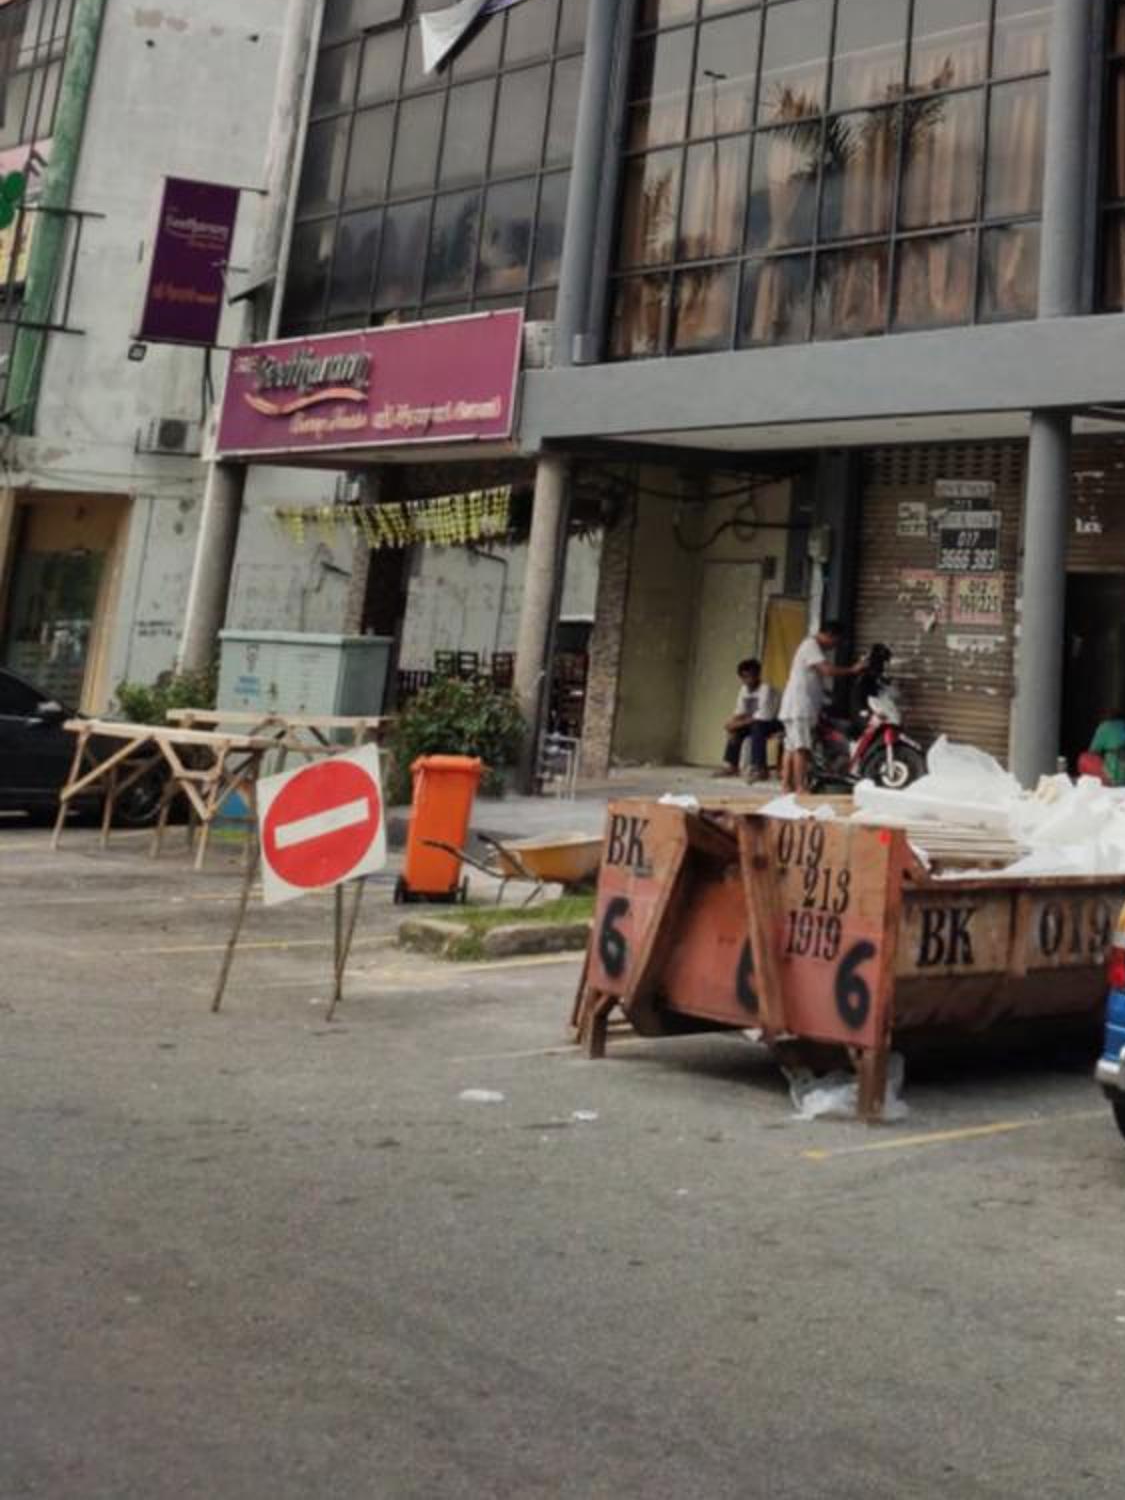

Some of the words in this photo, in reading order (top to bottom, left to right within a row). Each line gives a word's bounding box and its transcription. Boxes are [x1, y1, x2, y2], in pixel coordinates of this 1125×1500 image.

[606, 814, 649, 869] BK
[777, 821, 825, 868] 019
[600, 896, 630, 979] 6
[785, 909, 842, 961] 1919
[916, 907, 976, 968] BK
[834, 939, 877, 1030] 6
